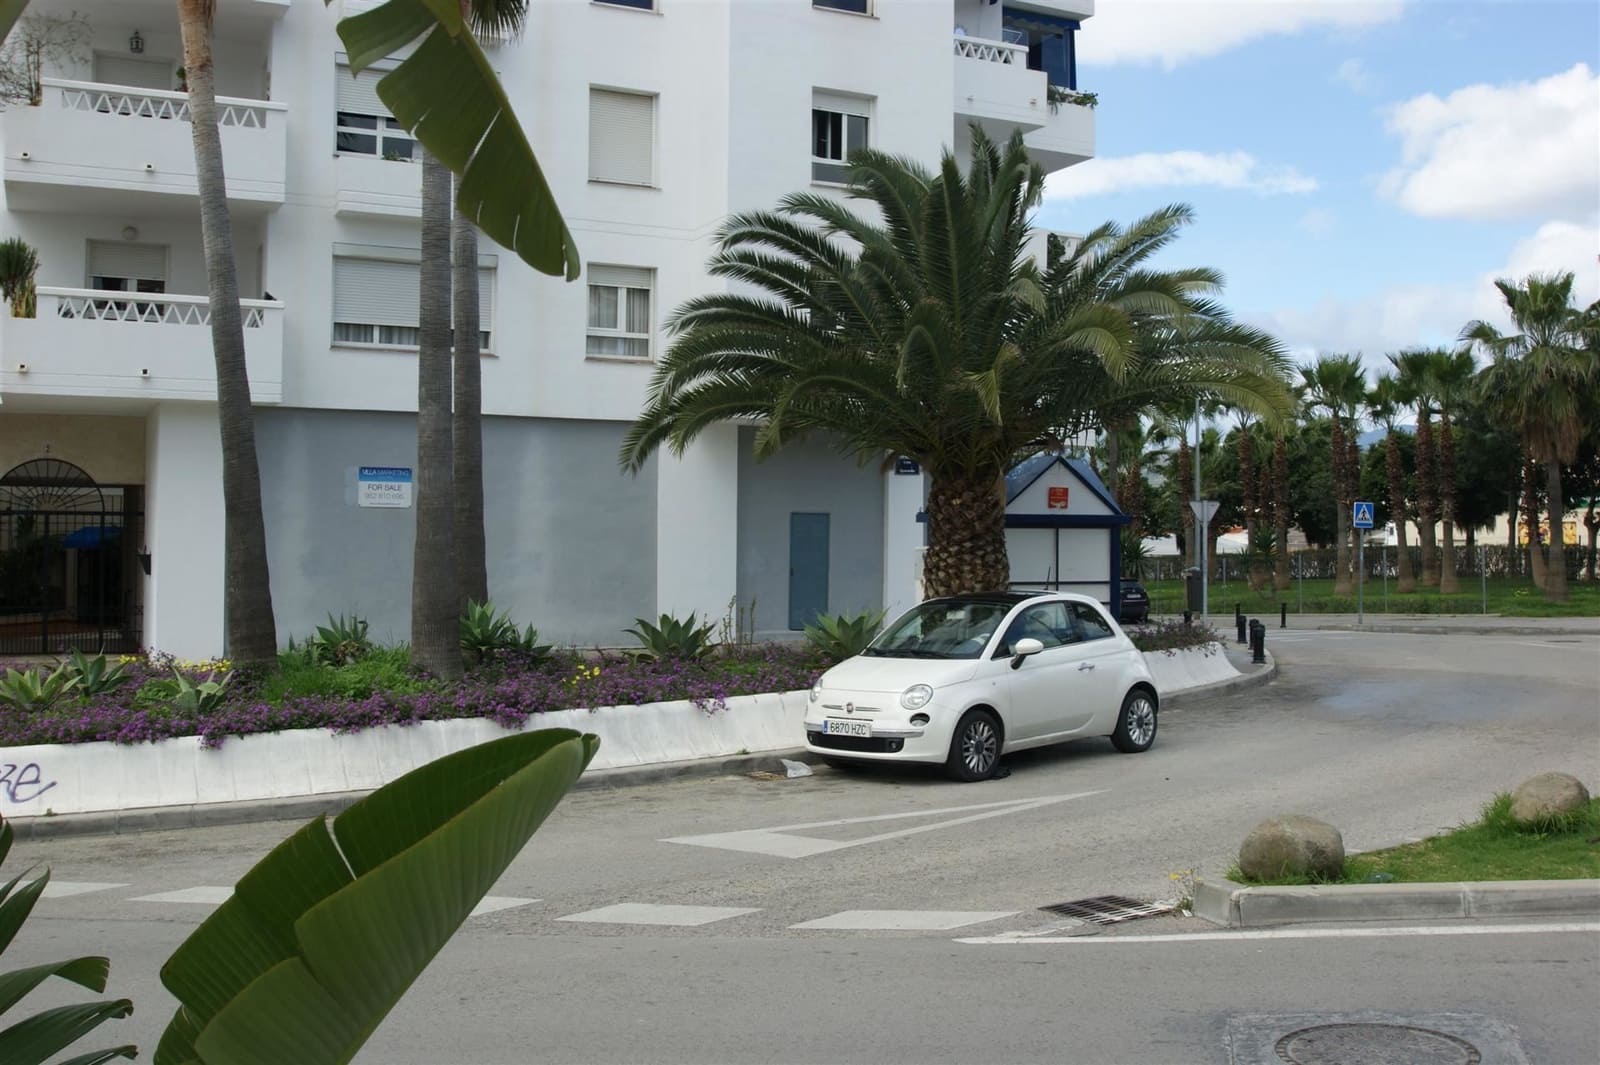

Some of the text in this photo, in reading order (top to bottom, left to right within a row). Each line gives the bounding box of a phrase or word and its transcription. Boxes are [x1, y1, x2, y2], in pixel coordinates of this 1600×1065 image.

[367, 483, 402, 492] FOR SALE
[830, 722, 850, 733] 6870
[851, 723, 867, 736] HZC
